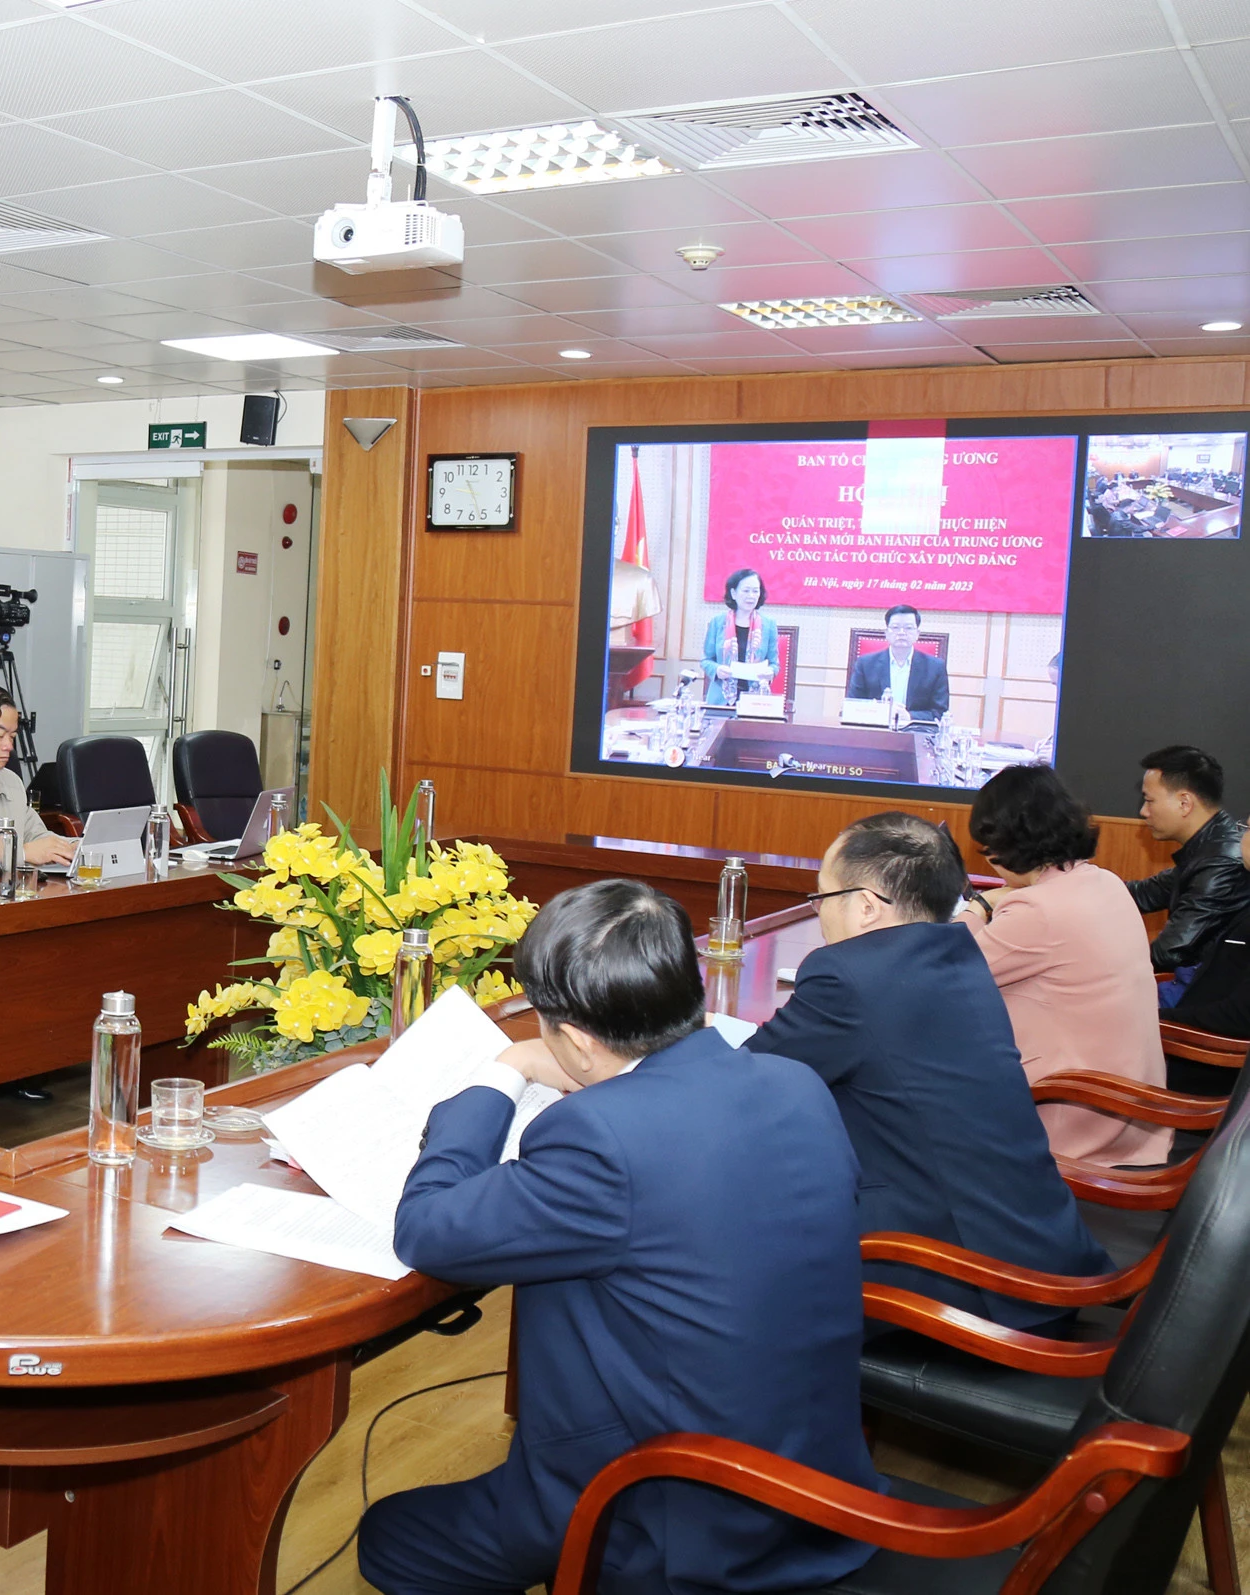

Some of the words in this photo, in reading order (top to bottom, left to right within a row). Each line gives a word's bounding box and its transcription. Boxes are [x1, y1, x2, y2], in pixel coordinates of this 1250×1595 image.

[153, 432, 169, 441] EXIT
[797, 455, 826, 467] BAN
[952, 452, 999, 465] ƯƠNG
[456, 464, 465, 476] 11
[468, 464, 479, 476] 12
[484, 464, 488, 475] 1
[444, 471, 454, 483] 10
[496, 471, 503, 482] 2
[439, 487, 446, 498] 9
[500, 487, 508, 498] 3
[444, 503, 451, 515] 8
[456, 509, 463, 520] 7
[480, 509, 488, 520] 5
[494, 504, 502, 514] 4
[468, 510, 475, 521] 6
[818, 515, 856, 531] TRIỆT,
[973, 516, 1008, 532] HIỆN
[749, 531, 774, 544] CÁC
[776, 532, 801, 545] VĂN
[830, 532, 855, 546] MỚI
[857, 535, 883, 546] BAN
[952, 536, 999, 548] TRUNG
[1002, 534, 1043, 548] ƯƠNG
[787, 547, 821, 562] CÔNG
[823, 549, 848, 562] TÁC
[870, 550, 907, 564] CHỨC
[908, 550, 936, 564] XÂY
[938, 552, 976, 567] DỰNG
[803, 577, 818, 587] Hà
[820, 576, 839, 589] Nội,
[841, 578, 864, 590] ngày
[867, 579, 879, 588] 17
[880, 578, 908, 591] tháng
[910, 580, 922, 590] 02
[924, 580, 946, 591] năm
[948, 581, 973, 591] 2023
[827, 765, 846, 775] TRU
[849, 767, 863, 776] SO
